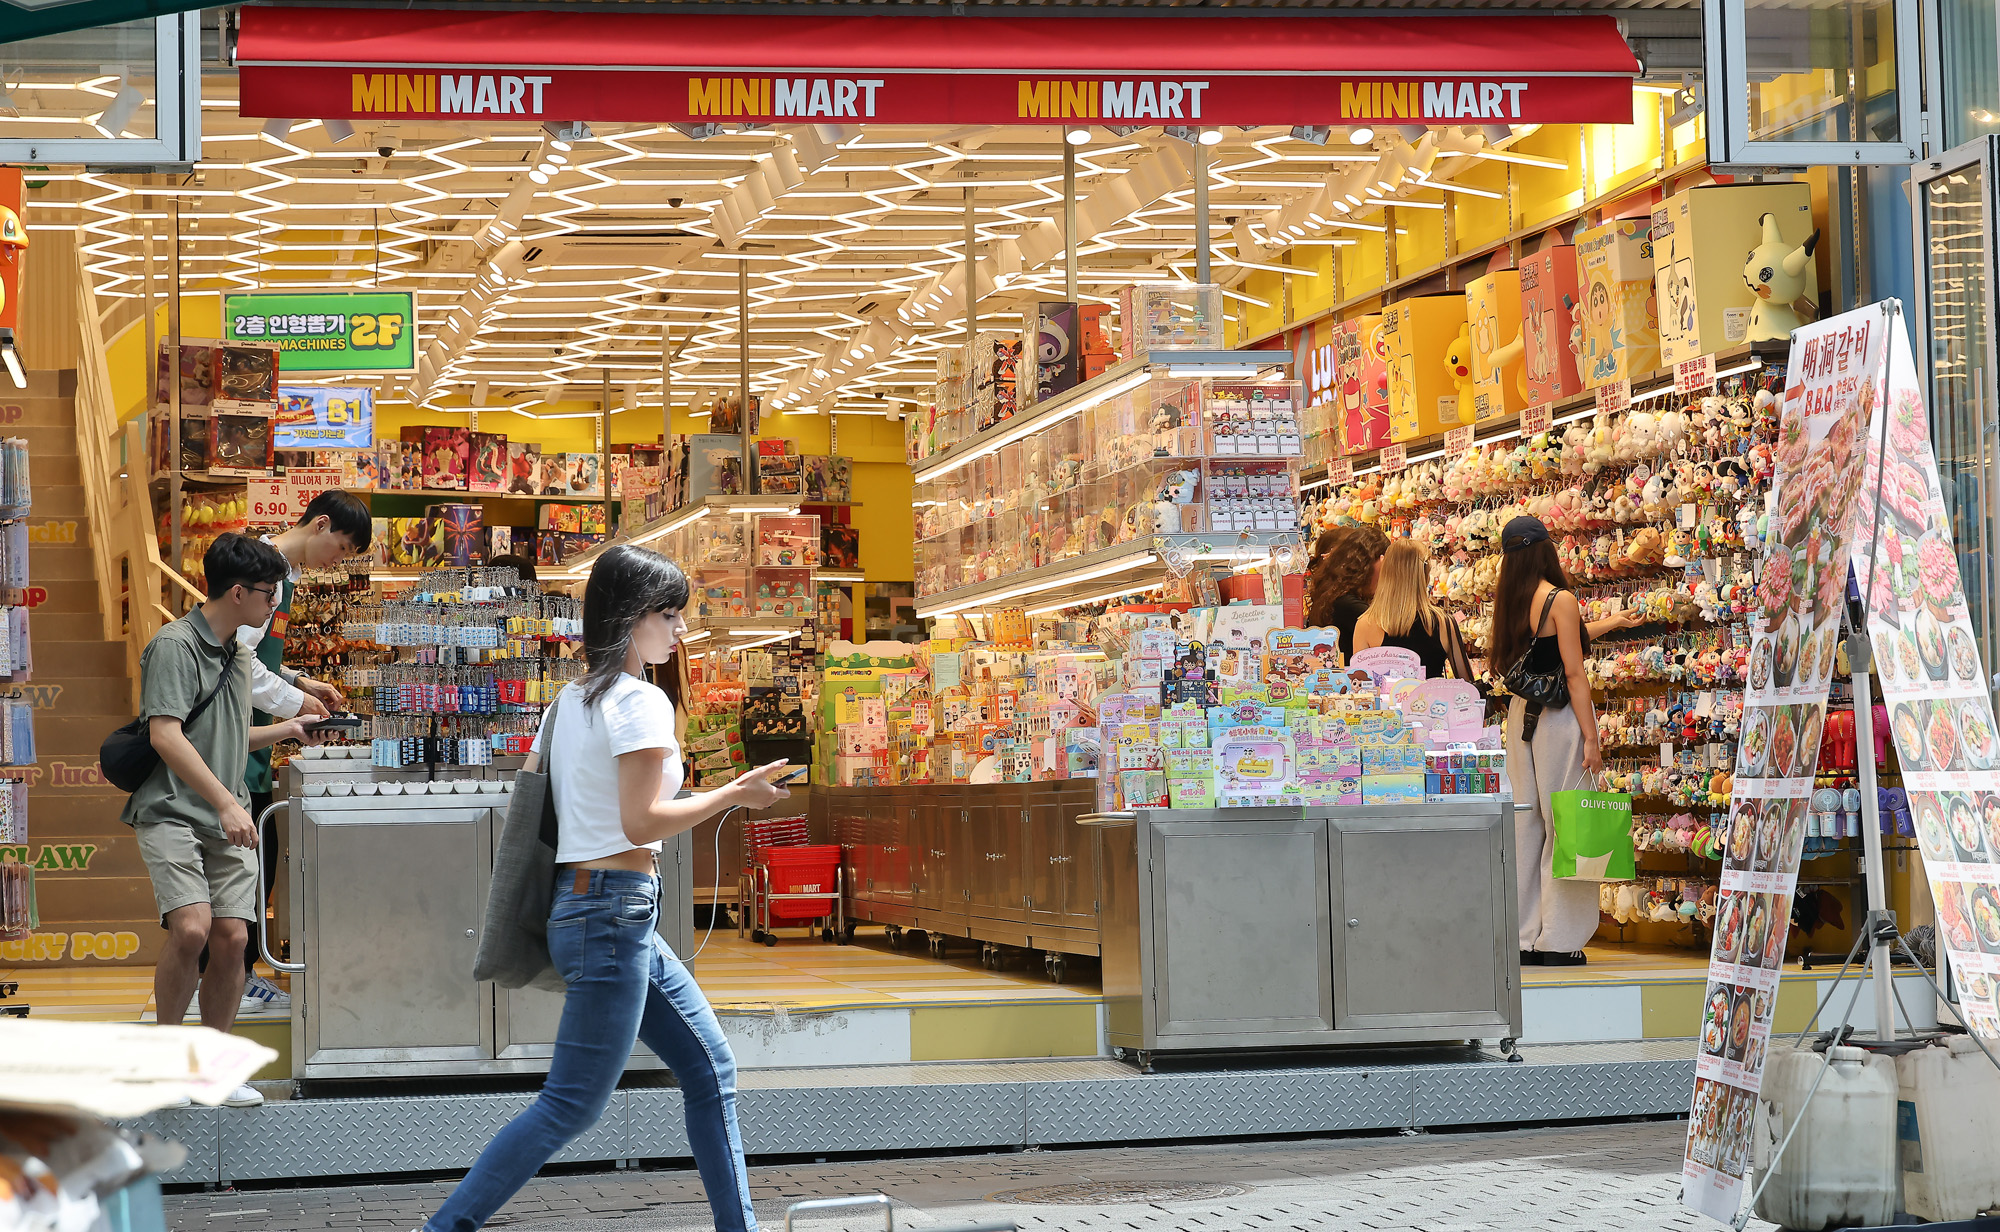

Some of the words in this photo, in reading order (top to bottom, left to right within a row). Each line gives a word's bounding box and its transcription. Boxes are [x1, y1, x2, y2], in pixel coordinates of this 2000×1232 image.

[352, 74, 435, 112] MINI
[440, 75, 551, 113] MART
[688, 78, 770, 116] MINI
[775, 78, 884, 117] MART
[1018, 80, 1098, 117] MINI
[1102, 81, 1209, 118] MART
[1340, 82, 1419, 118] MINI
[1423, 82, 1528, 118] MART
[235, 315, 266, 334] 2층
[269, 315, 345, 334] 인형뽑기
[351, 314, 402, 347] 2F
[279, 339, 346, 350] MACHINES
[1684, 372, 1705, 391] 9,900
[327, 398, 361, 424] B1
[1804, 385, 1833, 417] B.B.Q
[1276, 635, 1294, 645] TOY
[1581, 799, 1605, 809] OLIVE
[1607, 801, 1632, 811] YOUN
[789, 885, 802, 893] MINI
[803, 884, 821, 893] MART
[0, 933, 67, 959] CKY
[72, 933, 138, 959] POP
